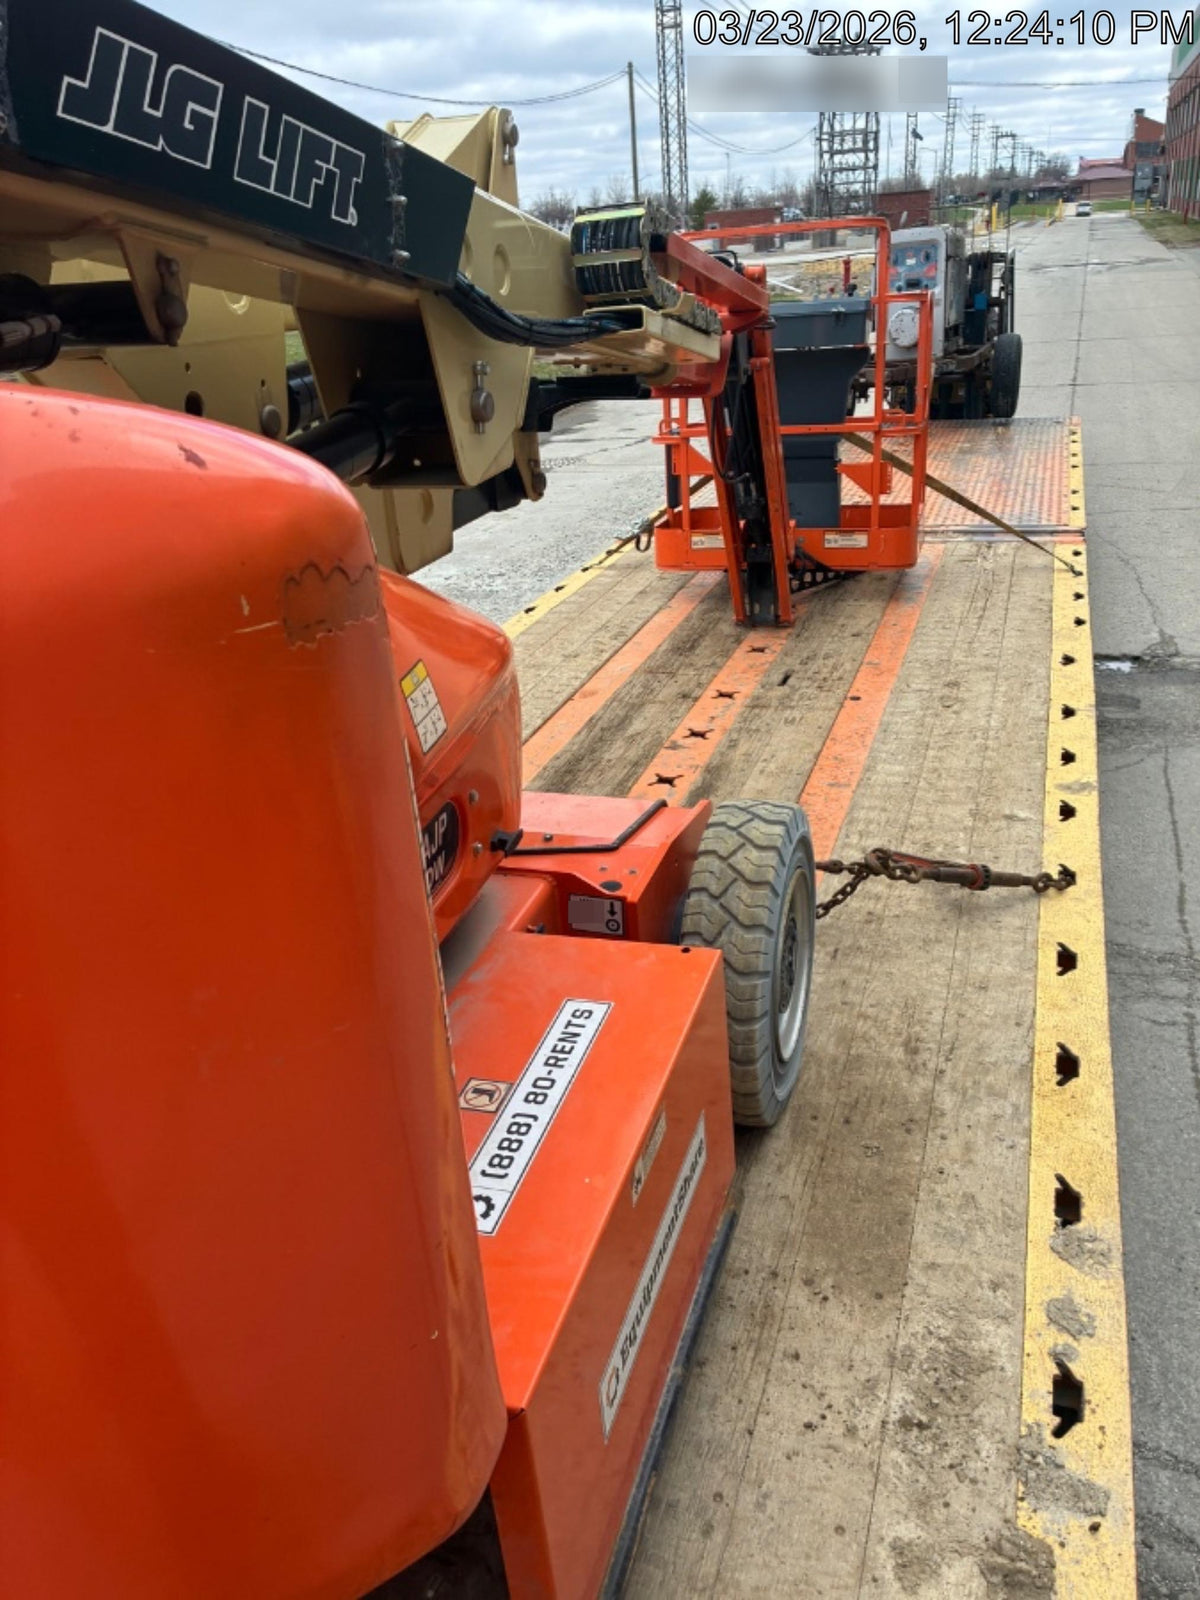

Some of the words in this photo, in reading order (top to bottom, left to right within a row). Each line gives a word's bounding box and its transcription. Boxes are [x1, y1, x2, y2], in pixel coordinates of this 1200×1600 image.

[57, 26, 224, 170] JLG
[422, 811, 447, 863] AJP
[480, 1112, 539, 1180] (888)
[523, 1007, 594, 1105] 80-RENTS
[620, 1137, 704, 1370] EquipmentShare
